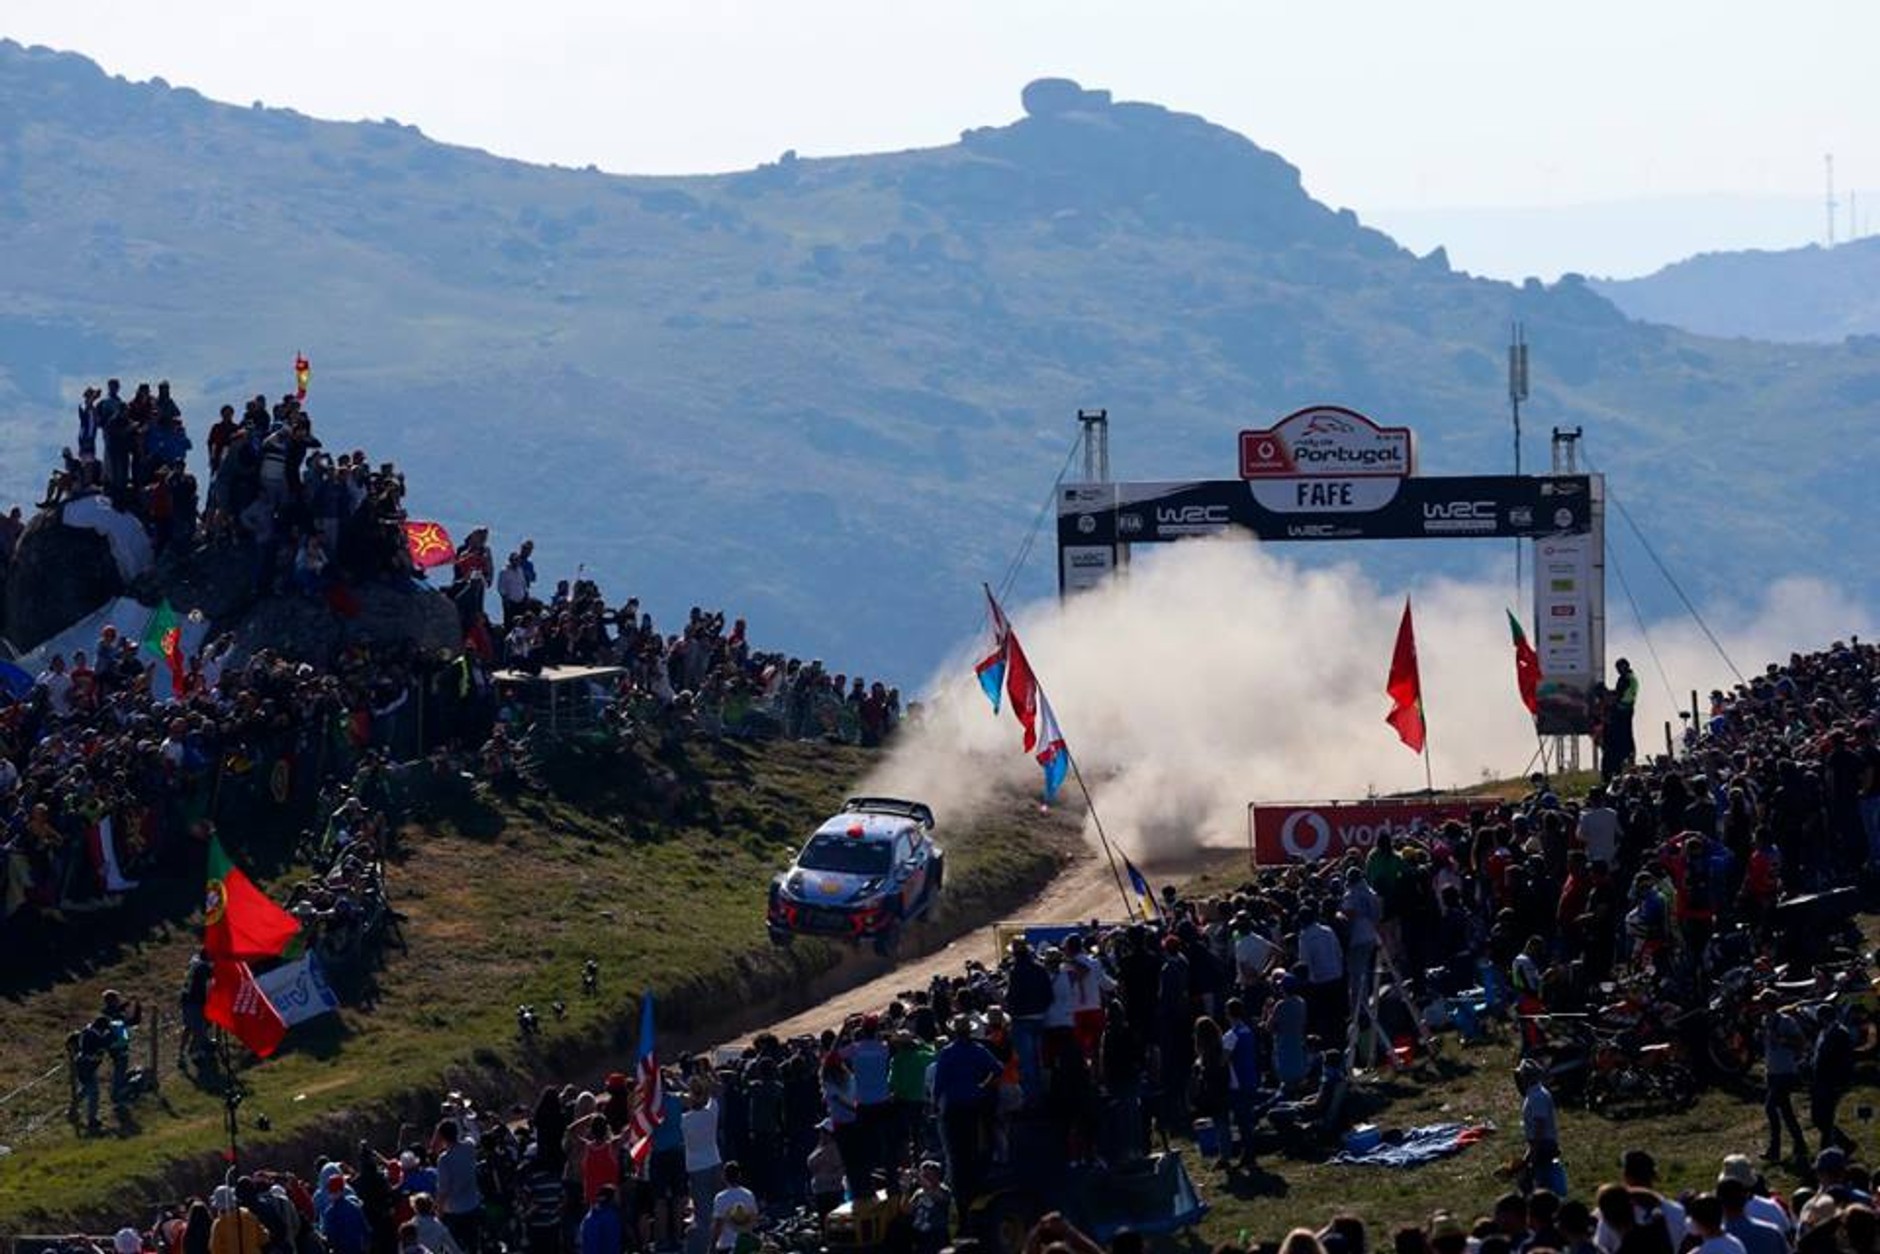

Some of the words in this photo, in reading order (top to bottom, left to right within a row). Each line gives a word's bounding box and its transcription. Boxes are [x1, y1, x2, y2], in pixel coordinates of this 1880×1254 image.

[1293, 446, 1402, 464] Portugal
[1297, 482, 1354, 506] FAFE
[1157, 505, 1229, 523] WRC
[1423, 501, 1497, 519] WRC
